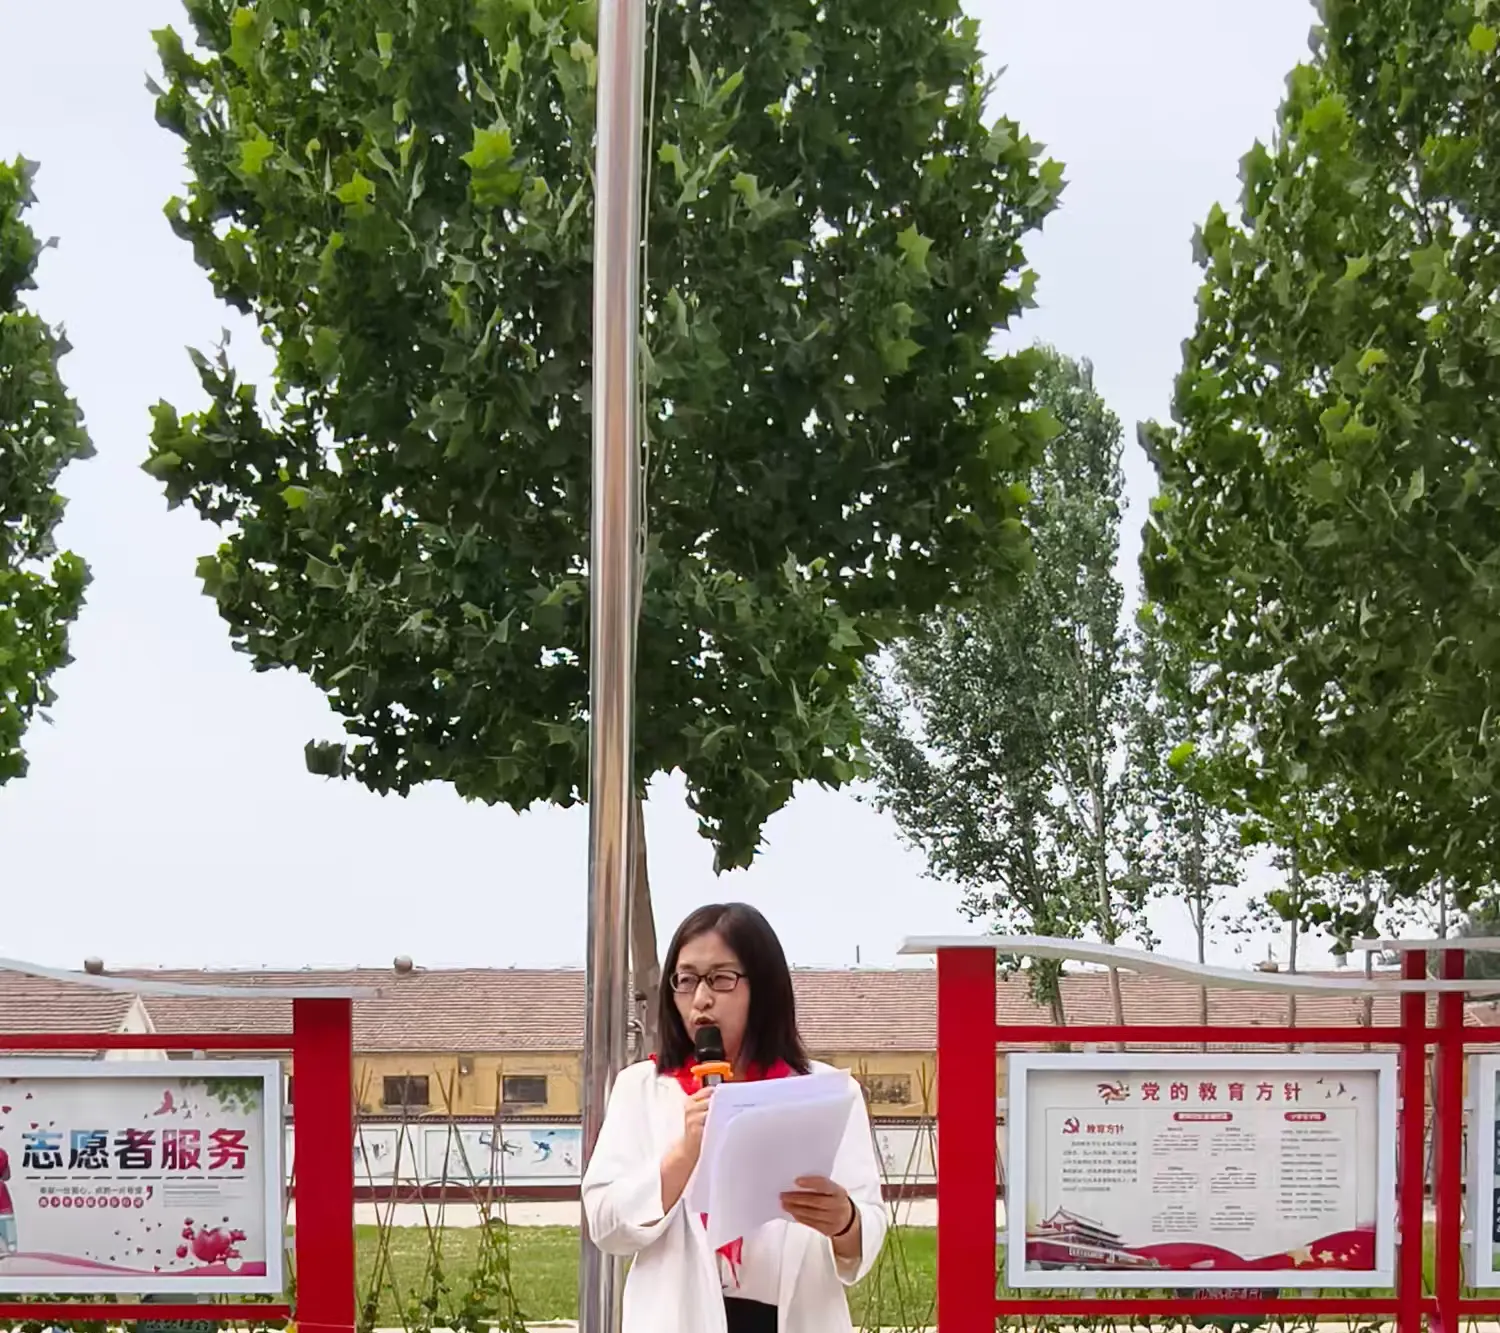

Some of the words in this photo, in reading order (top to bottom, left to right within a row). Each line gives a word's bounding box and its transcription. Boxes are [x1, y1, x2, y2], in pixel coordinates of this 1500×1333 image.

[1141, 1082, 1302, 1102] 党的教育方针
[22, 1128, 249, 1170] 志愿者服务
